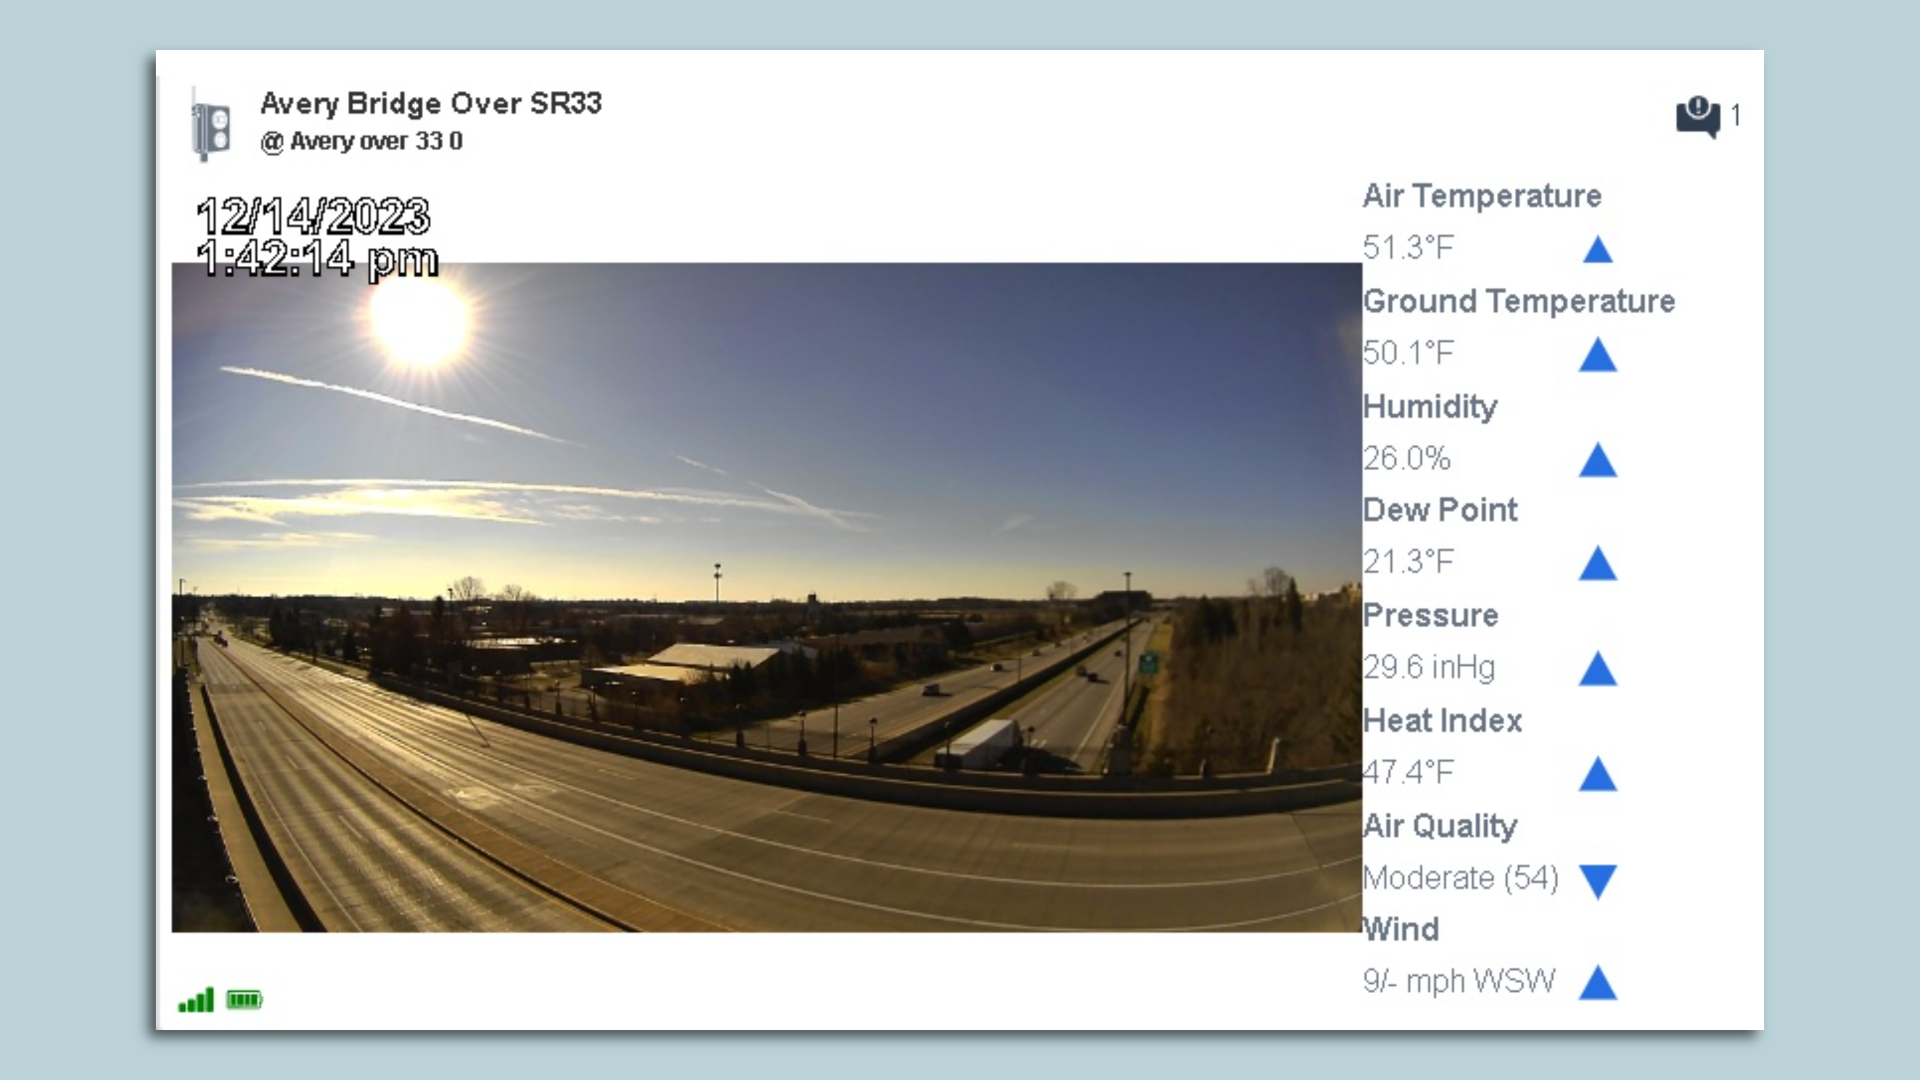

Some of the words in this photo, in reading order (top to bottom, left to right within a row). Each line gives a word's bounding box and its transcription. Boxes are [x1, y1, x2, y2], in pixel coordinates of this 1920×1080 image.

[261, 91, 339, 120] Avery
[348, 91, 441, 120] Bridge
[451, 91, 522, 114] Over
[531, 91, 602, 114] SR33
[1731, 103, 1740, 127] 1
[261, 131, 284, 156] @
[290, 131, 355, 154] Avery
[360, 135, 409, 150] over
[416, 131, 443, 150] 33
[450, 131, 463, 150] 0
[1363, 183, 1405, 207] Air
[1412, 183, 1601, 213] Temperature
[1363, 234, 1454, 259] 51.3°F
[1363, 288, 1476, 313] Ground
[1485, 288, 1675, 319] Temperature
[1363, 340, 1454, 364] 50.1°F
[1363, 394, 1498, 424] Humidity
[1363, 445, 1450, 470] 26.0%
[1363, 497, 1431, 522] Dew
[1440, 497, 1518, 522] Point
[1363, 549, 1454, 573] 21.3°F
[1363, 602, 1498, 627] Pressure
[1363, 654, 1423, 679] 29.6
[1434, 654, 1494, 684] inHg
[1363, 708, 1433, 732] Heat
[1442, 708, 1522, 732] Index
[1363, 759, 1454, 784] 47.4°F
[1363, 813, 1405, 838] Air
[1414, 813, 1518, 843] Quality
[1363, 865, 1494, 889] Moderate
[1505, 865, 1558, 895] (54)
[1363, 916, 1438, 941] Wind
[1363, 968, 1397, 993] 9/-
[1408, 968, 1464, 998] mph
[1473, 968, 1556, 993] WSW
